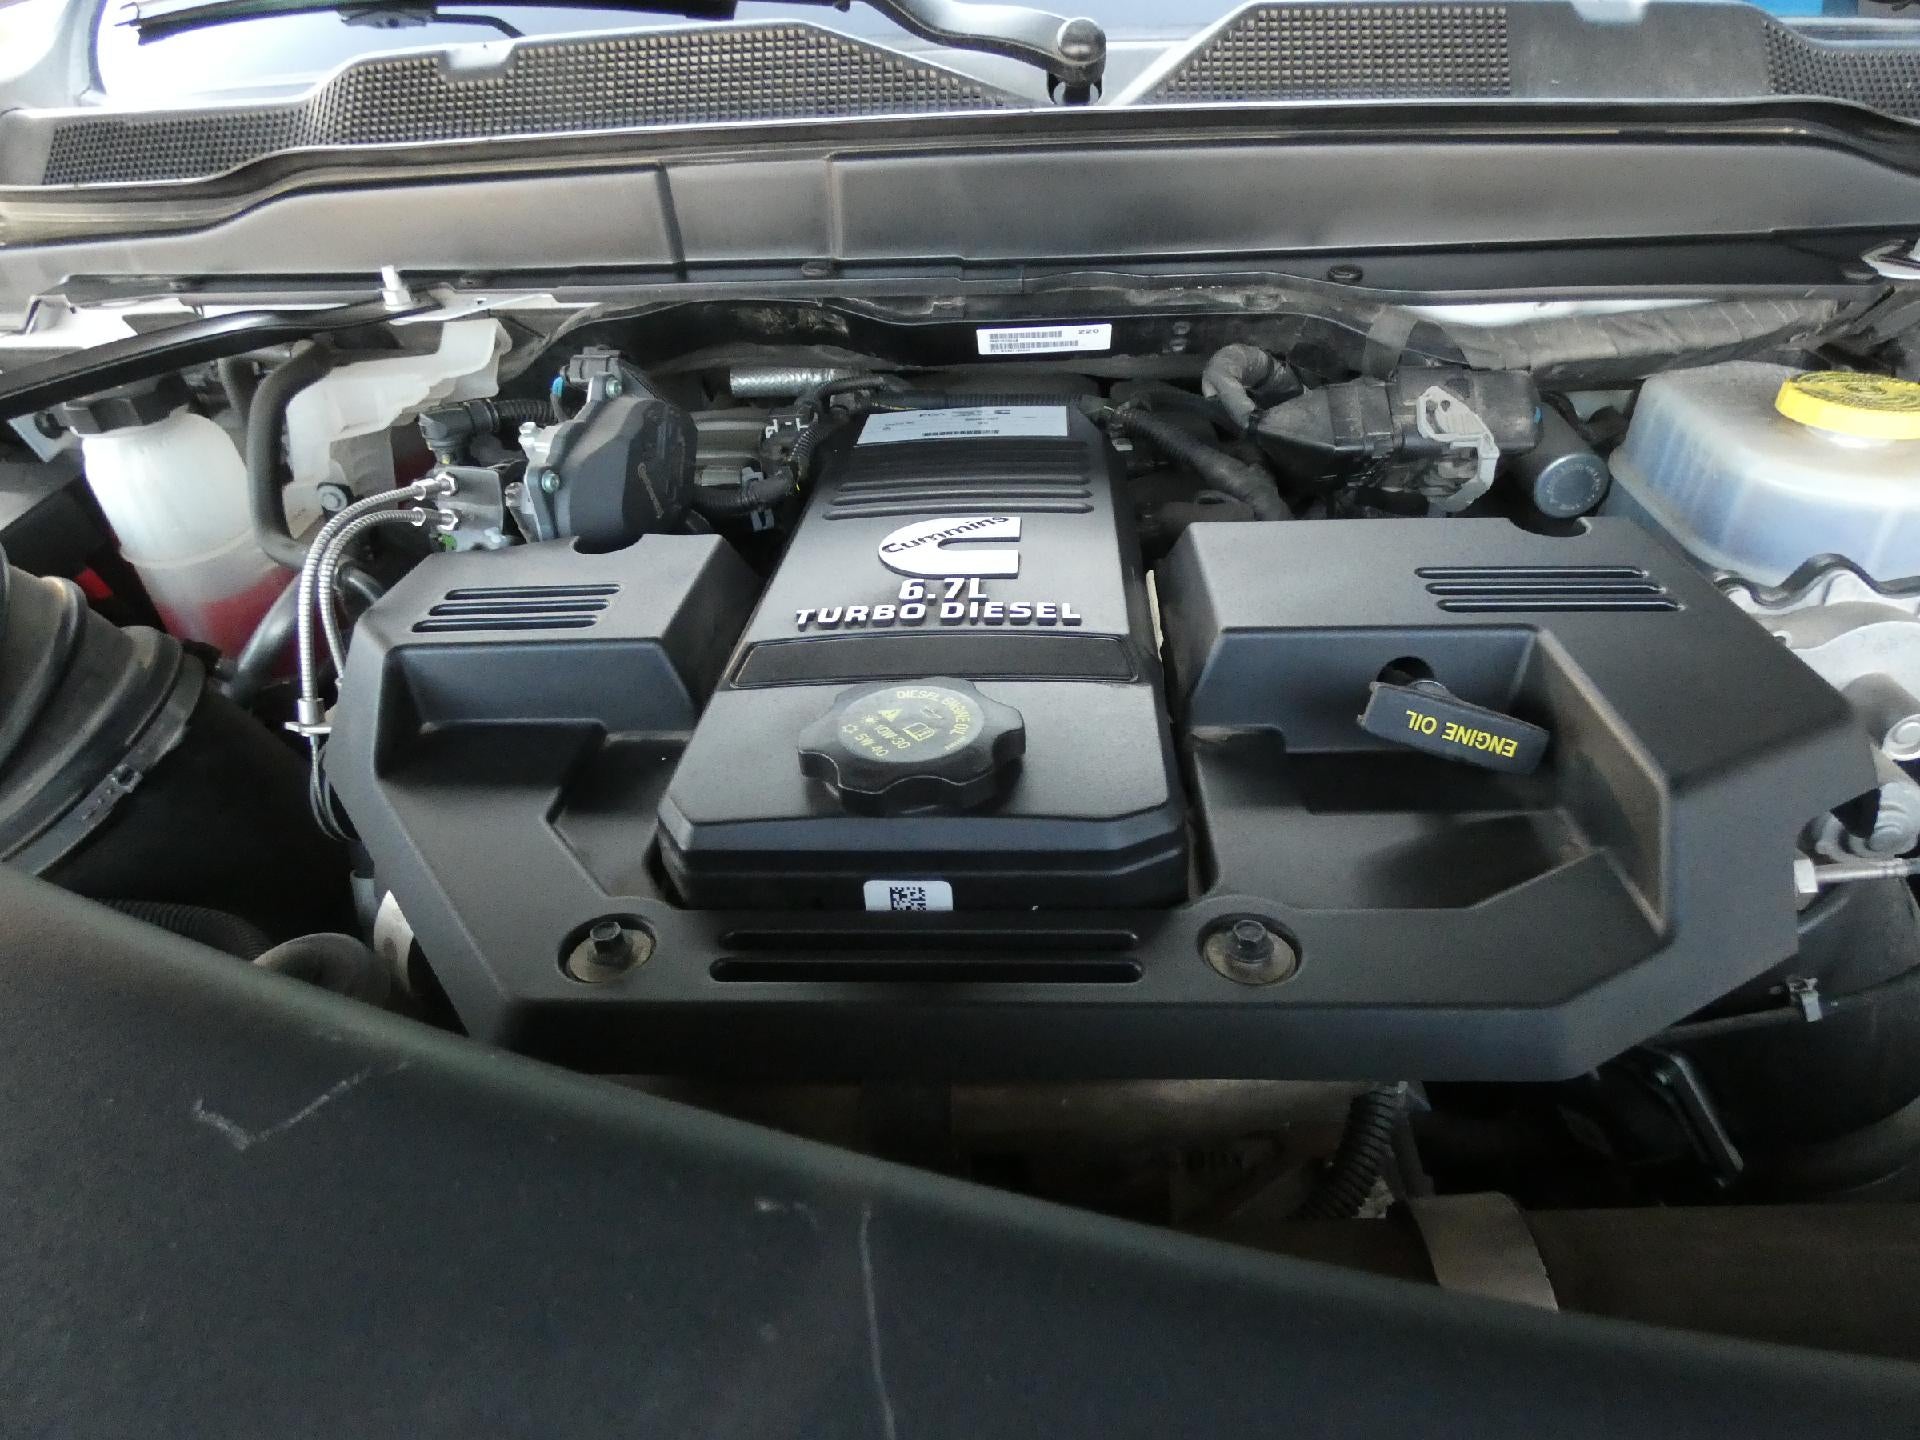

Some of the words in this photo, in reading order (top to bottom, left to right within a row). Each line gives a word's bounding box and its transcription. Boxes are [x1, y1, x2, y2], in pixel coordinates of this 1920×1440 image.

[881, 515, 1009, 554] Cummins
[898, 577, 988, 602] 6.7L
[795, 602, 927, 627] TURBO
[939, 601, 1082, 624] DIESEL
[896, 690, 940, 701] DIESEL
[941, 697, 971, 723] ENGINE
[1405, 710, 1438, 735] OIL
[1441, 721, 1519, 758] ENGINE
